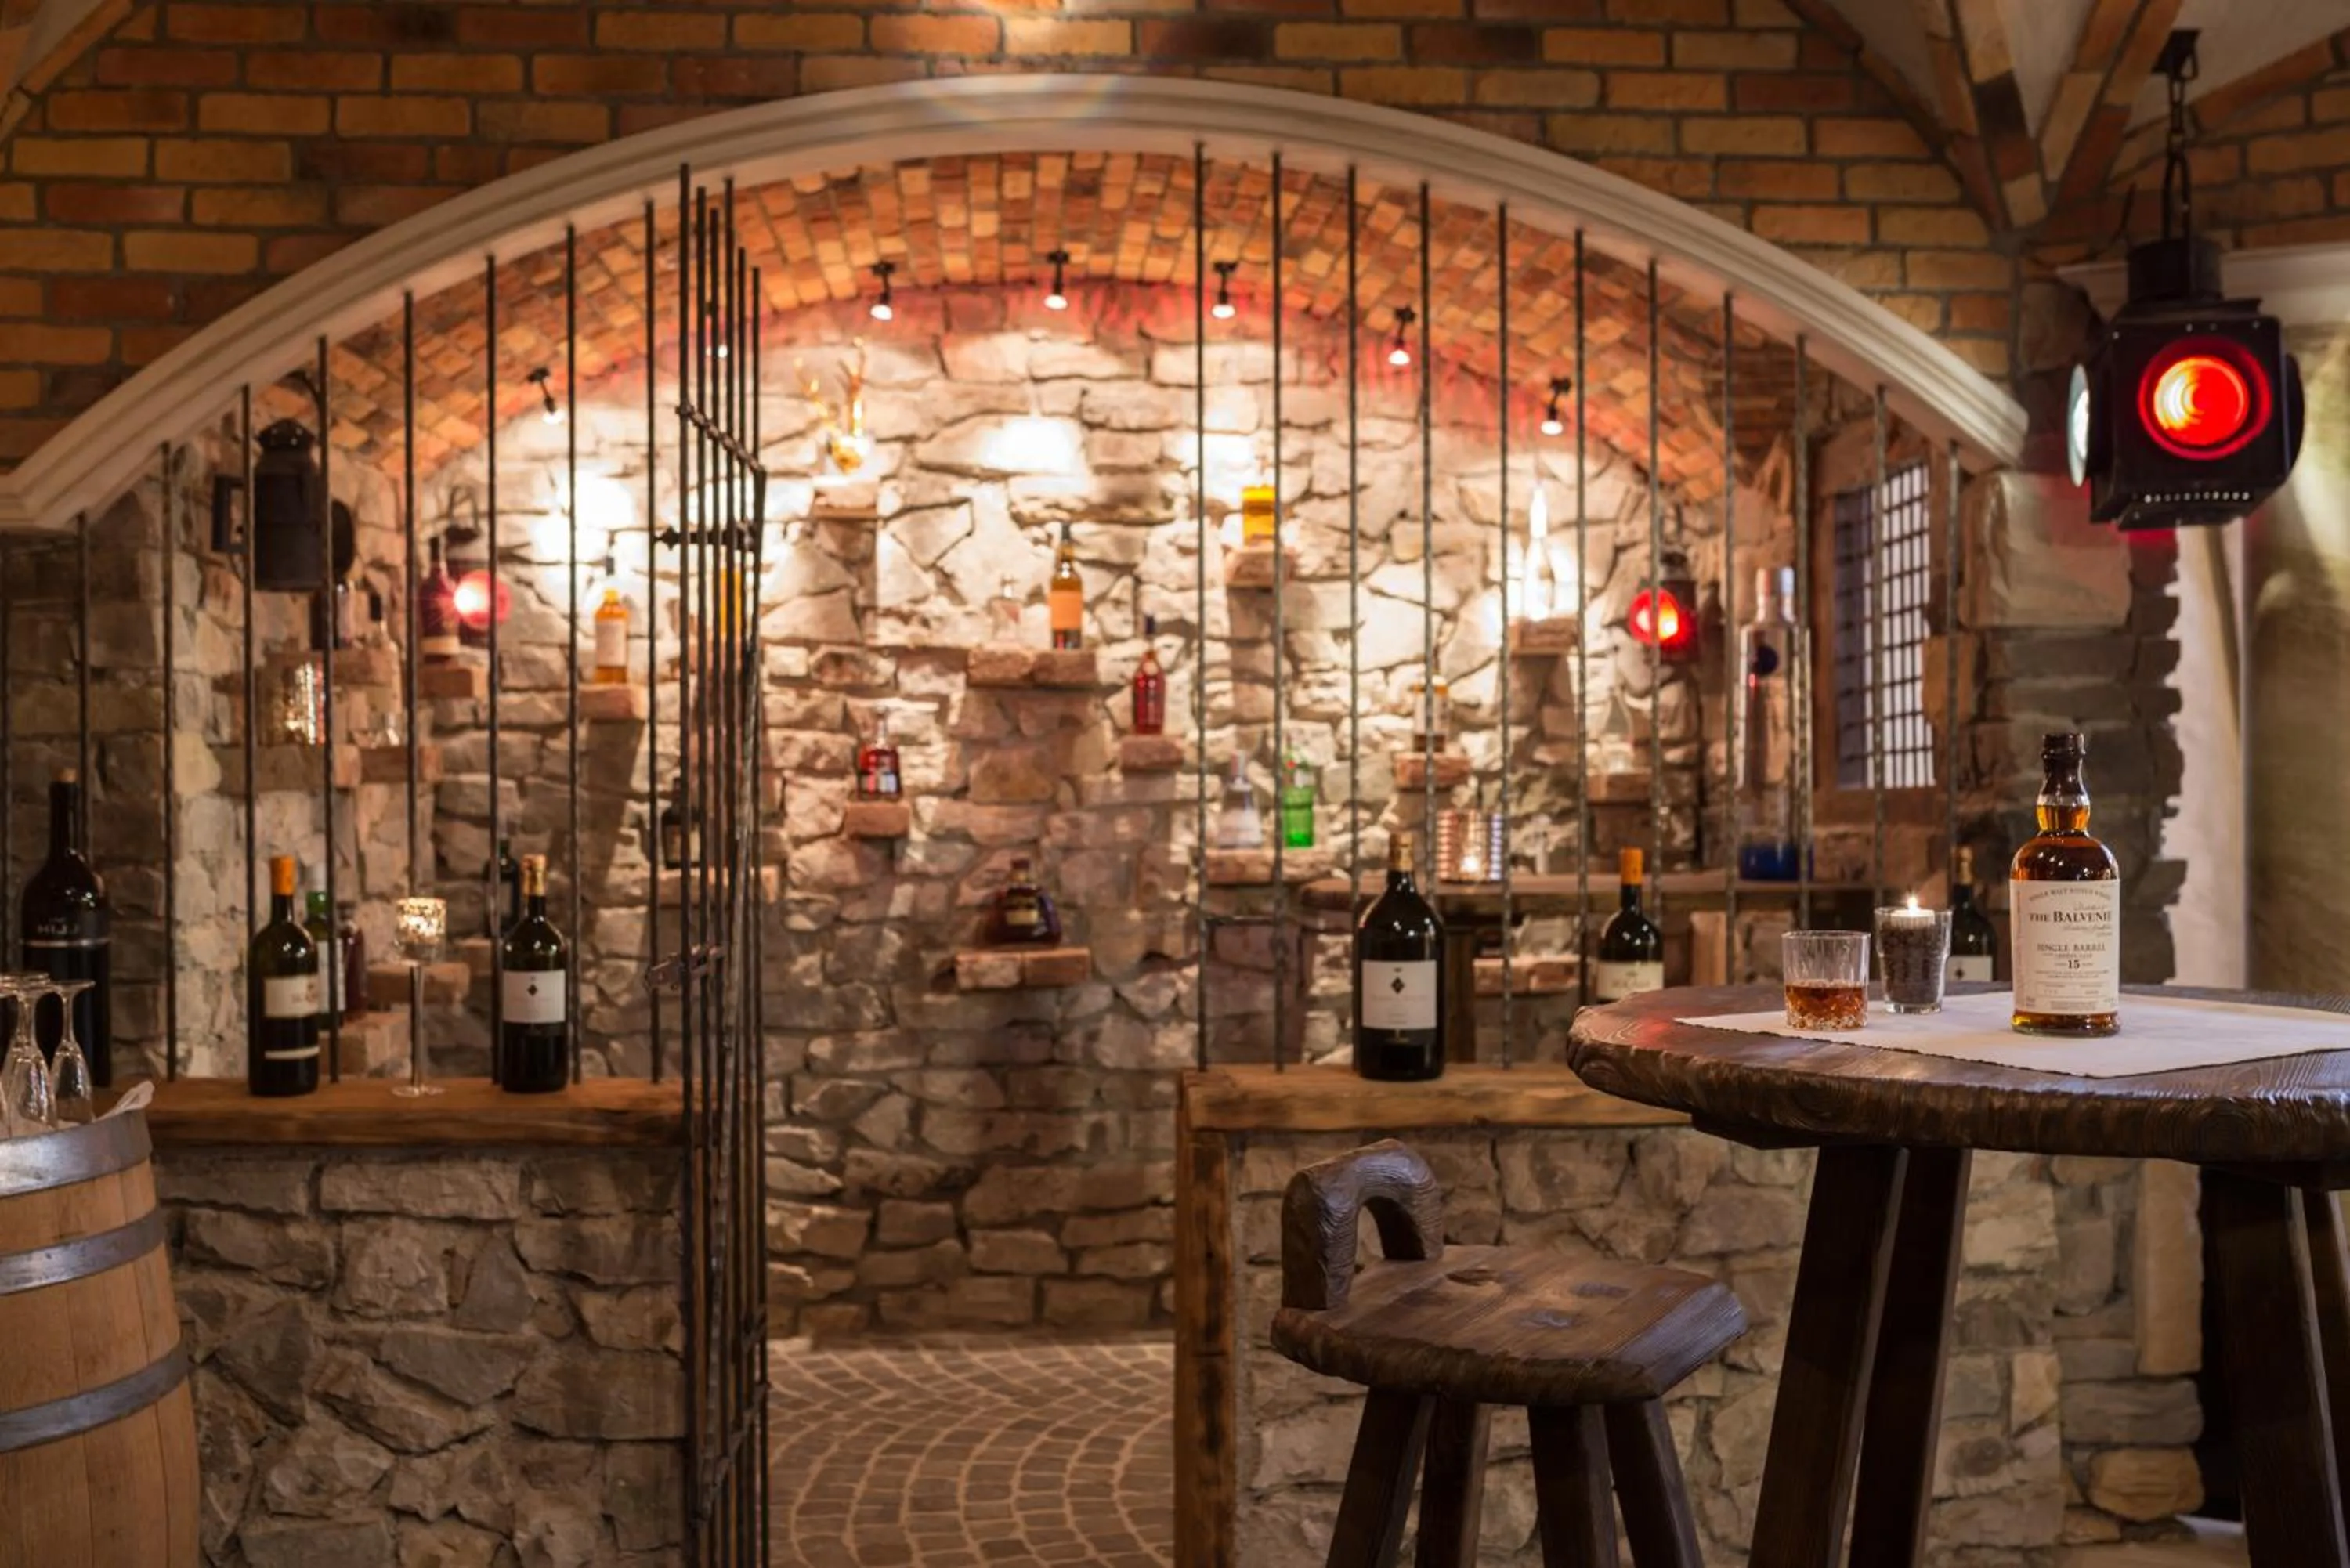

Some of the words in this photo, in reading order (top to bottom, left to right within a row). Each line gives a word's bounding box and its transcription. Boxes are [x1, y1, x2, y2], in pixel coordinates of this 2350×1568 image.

[2028, 912, 2049, 922] THE
[2073, 942, 2106, 952] BARREL
[2067, 959, 2080, 970] 15
